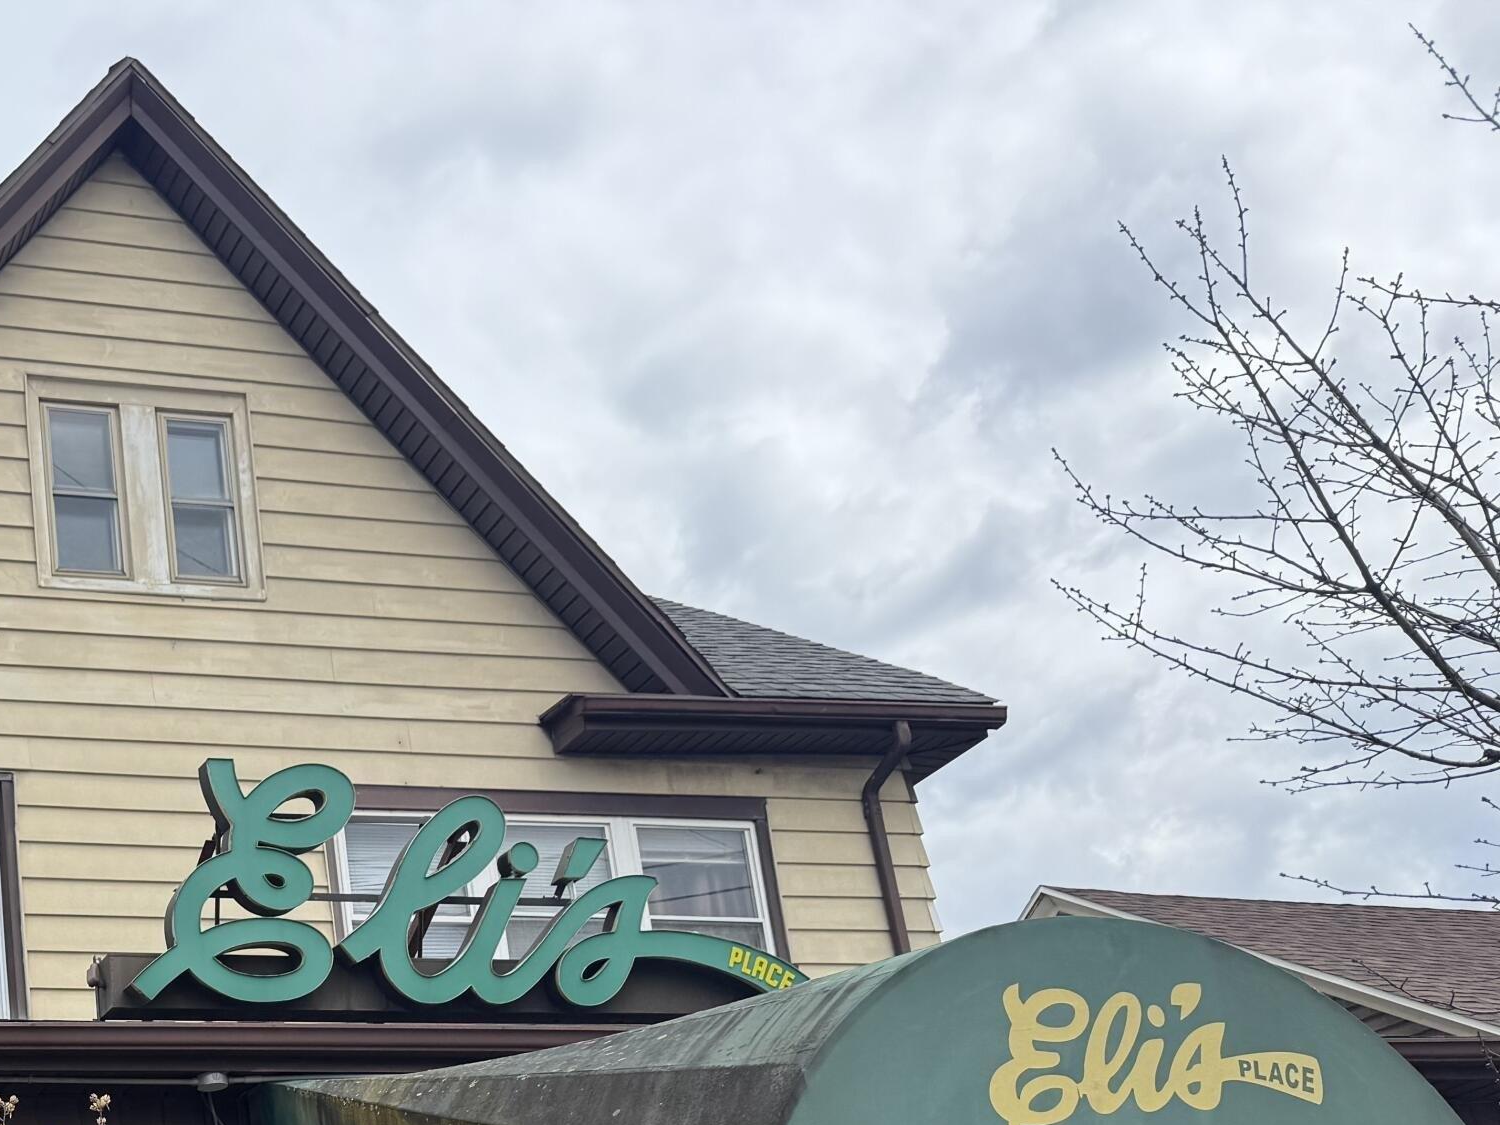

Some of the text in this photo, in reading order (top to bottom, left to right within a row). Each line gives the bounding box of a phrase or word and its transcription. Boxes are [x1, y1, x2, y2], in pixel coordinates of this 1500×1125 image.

[126, 758, 670, 1006] Eli's
[728, 946, 797, 990] PLACE
[1238, 1059, 1316, 1094] PLACE
